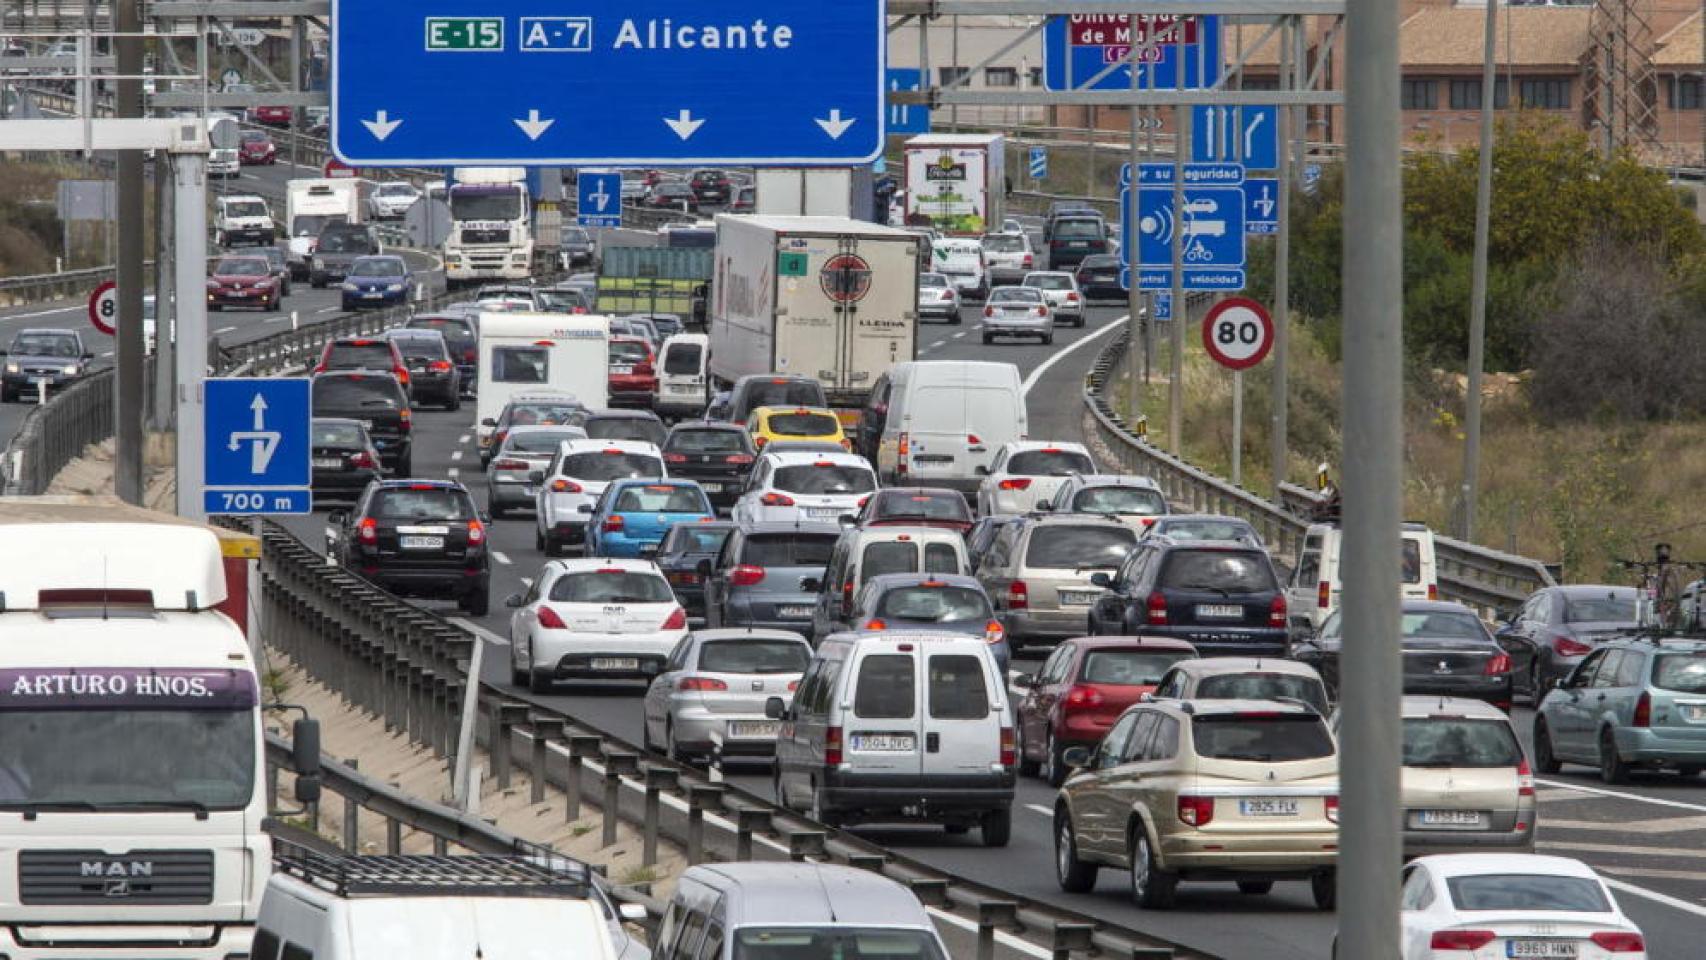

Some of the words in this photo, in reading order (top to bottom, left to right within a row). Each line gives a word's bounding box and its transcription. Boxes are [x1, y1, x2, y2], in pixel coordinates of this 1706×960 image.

[429, 22, 499, 47] E-15
[613, 18, 793, 49] Alicante
[1081, 28, 1104, 43] de
[102, 299, 114, 317] 8
[1218, 321, 1258, 345] 80
[222, 493, 265, 510] 700
[275, 497, 292, 510] m
[12, 675, 128, 696] ARTURO
[135, 675, 215, 697] HNOS.
[81, 861, 152, 876] MAN
